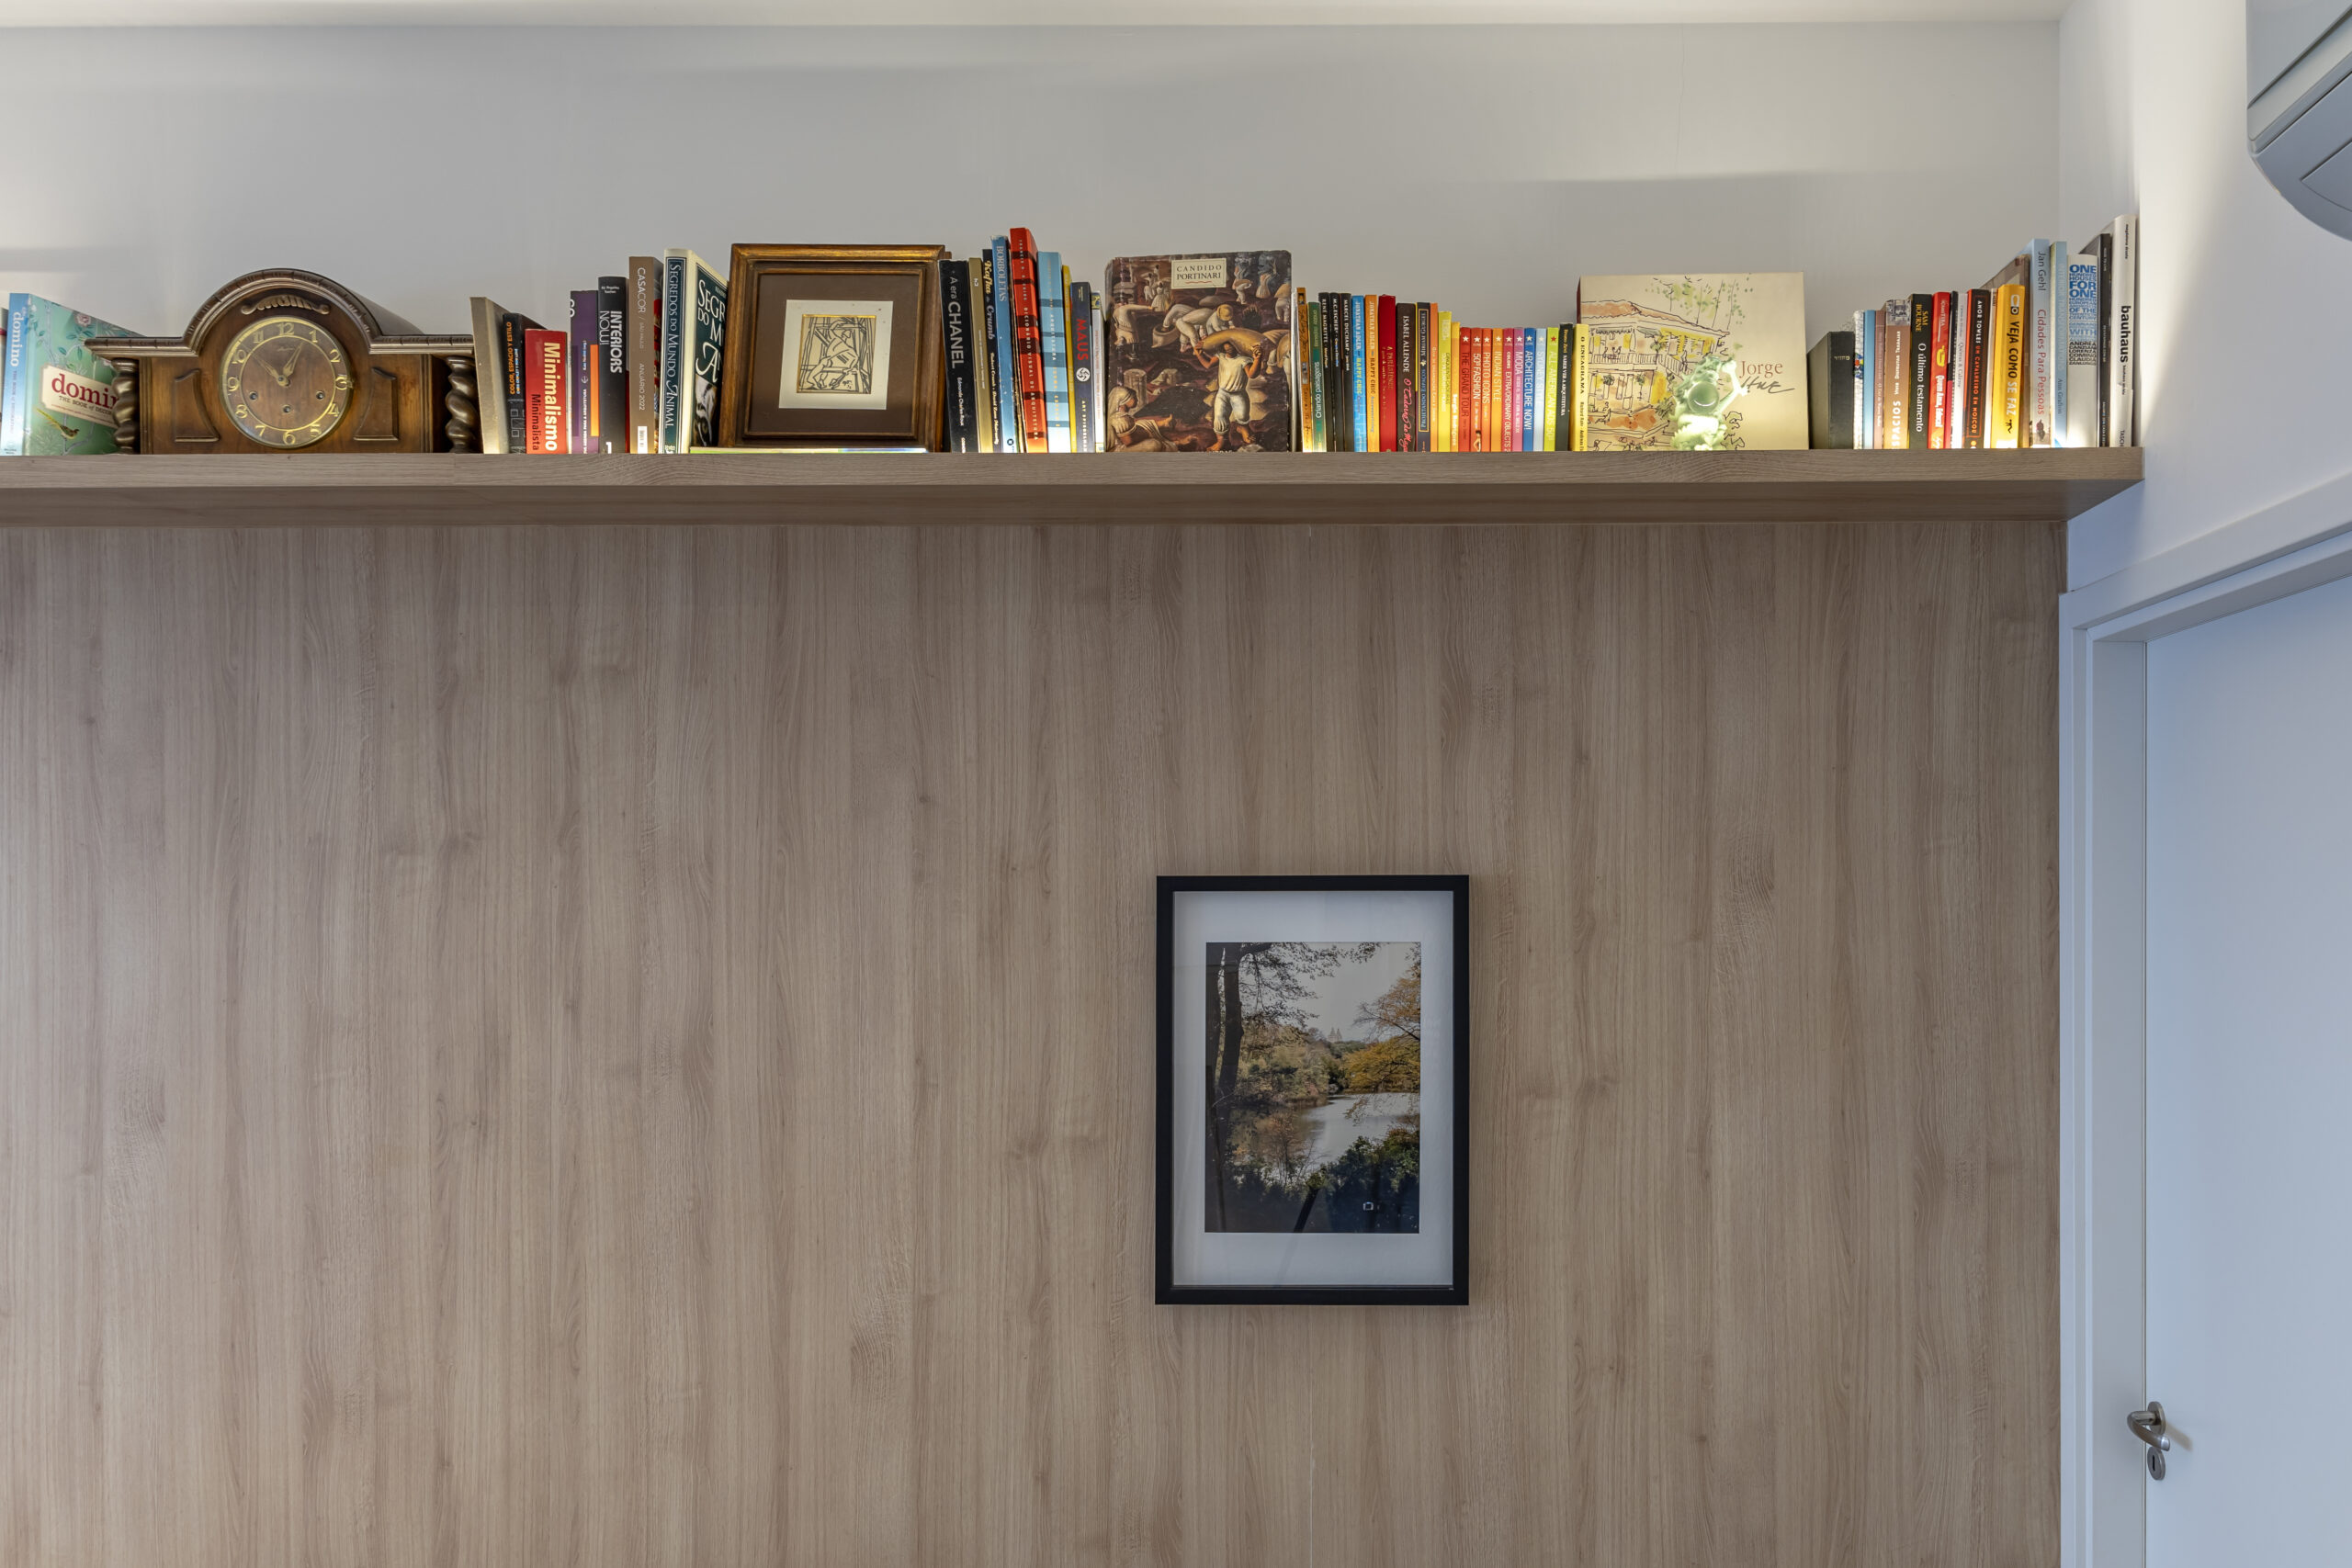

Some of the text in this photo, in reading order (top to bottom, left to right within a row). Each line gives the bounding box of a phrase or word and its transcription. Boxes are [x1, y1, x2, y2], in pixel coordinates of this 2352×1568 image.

[996, 245, 1007, 301] BORBOLETAS
[1176, 265, 1223, 273] CANDIDO
[1176, 272, 1221, 280] PORTINARI
[2069, 265, 2097, 274] ONE
[637, 267, 647, 313] CASACOR
[669, 264, 682, 316] SEGREDOS
[2069, 281, 2097, 290] FOR
[2069, 289, 2097, 299] ONE
[698, 279, 727, 322] SEGR
[982, 260, 996, 340] Kafka Crumb
[277, 322, 296, 336] 12
[599, 310, 610, 345] NOW!
[670, 318, 677, 332] DO
[698, 308, 709, 326] DO
[10, 311, 25, 367] domino
[310, 330, 318, 343] 1
[609, 310, 623, 374] INTERIORS
[947, 300, 964, 369] CHANEL
[1076, 319, 1089, 361] MAUS
[2037, 251, 2046, 415] Jan Gehl Cidades Para Pessoas
[2120, 305, 2132, 363] bauhaus
[232, 349, 247, 364] 10
[330, 349, 341, 363] 2
[667, 333, 680, 378] MUNDO
[1514, 351, 1523, 375] MODA
[1975, 345, 1981, 354] UM
[1404, 378, 1412, 386] O
[1494, 351, 1502, 402] INDIAN STYLE
[1536, 351, 1545, 404] SYDNEY STYLE
[1738, 360, 1784, 378] Jorge
[1973, 356, 1981, 395] CAVALHEIRO
[2006, 321, 2019, 416] VEJA COMO SE FAZ
[227, 377, 240, 391] 9
[335, 377, 348, 390] 3
[544, 342, 562, 452] Minimalismo
[1029, 380, 1035, 389] DE
[1313, 361, 1322, 419] Criando paisagens
[1473, 367, 1481, 400] FASHION
[1524, 350, 1532, 430] ARCHITECTURE NOW!
[1547, 351, 1556, 424] ALL-AMERICAN ADS
[1916, 343, 1927, 433] O último testamento
[1935, 375, 1945, 391] Quem
[59, 395, 88, 409] THE BOOK
[235, 404, 249, 419] 8
[328, 403, 339, 417] 4
[665, 379, 679, 429] ANIMAL
[1401, 386, 1412, 423] Caderno
[1973, 397, 1978, 405] EM
[255, 424, 266, 437] 7
[311, 423, 322, 437] 5
[531, 394, 542, 451] Minimalista
[1030, 392, 1039, 441] ARQUITETURA
[1403, 423, 1410, 433] de
[1890, 400, 1902, 449] SPACIOS
[283, 430, 296, 446] 6
[605, 441, 613, 454] 1
